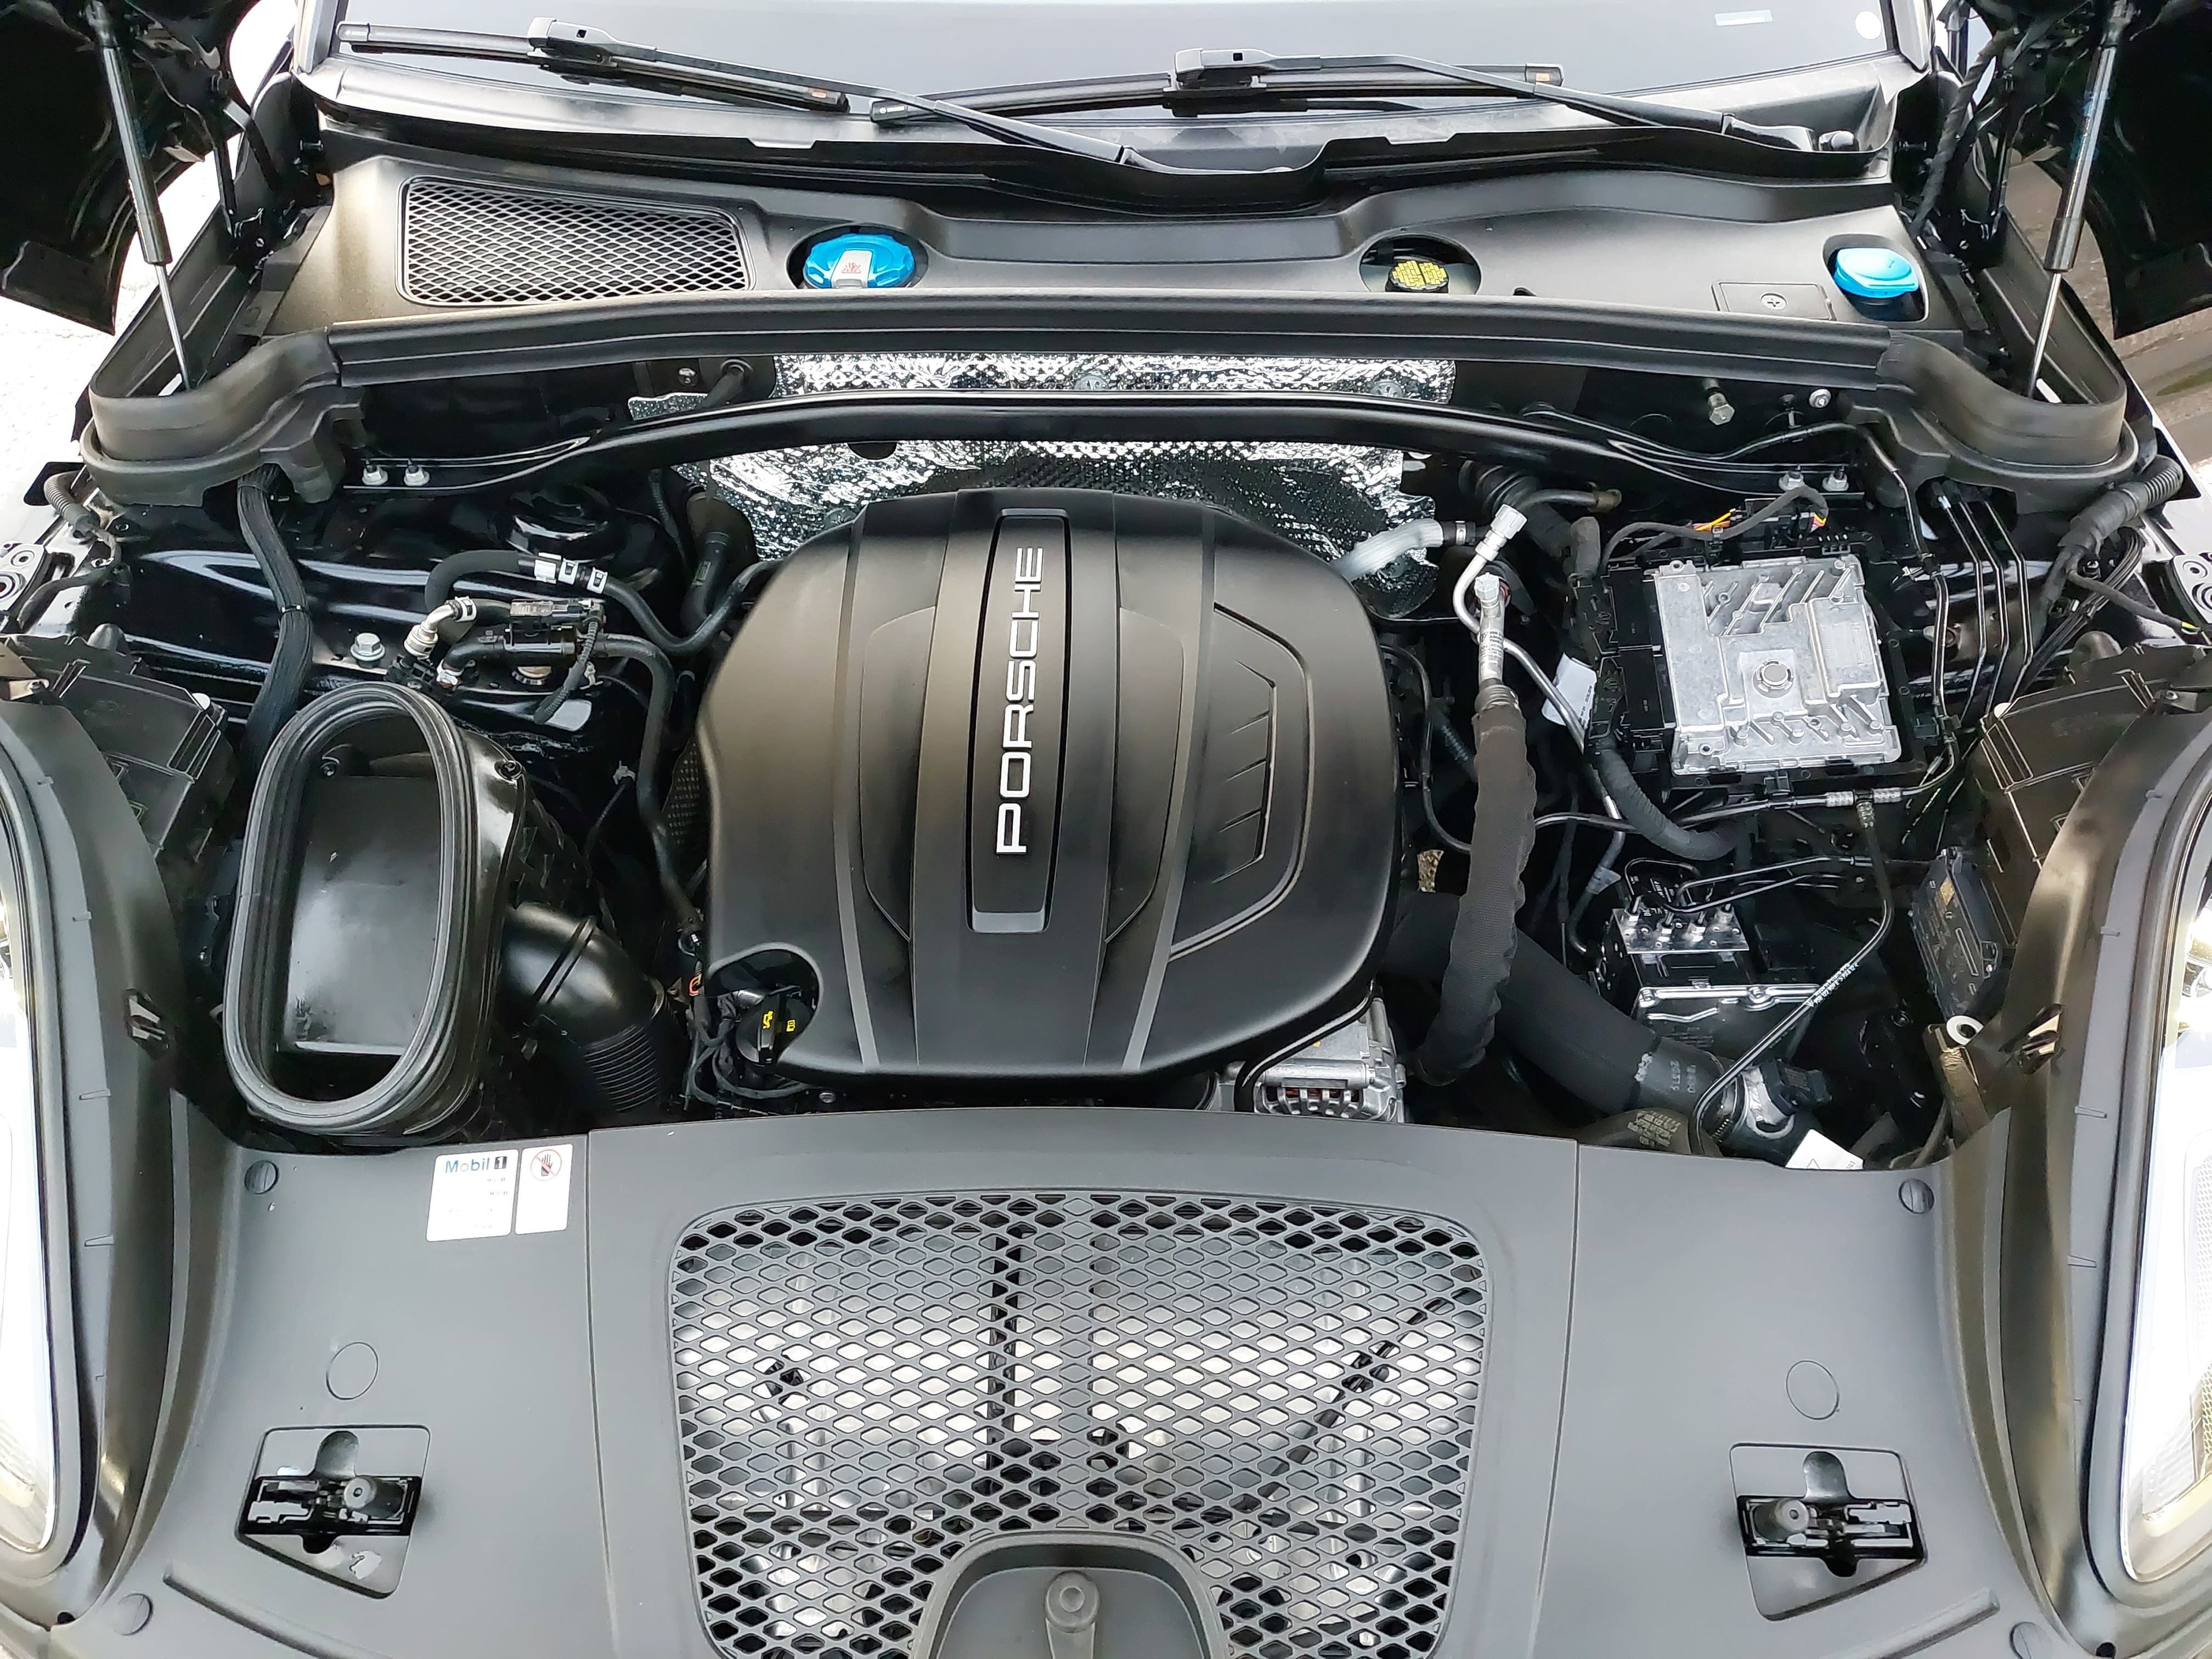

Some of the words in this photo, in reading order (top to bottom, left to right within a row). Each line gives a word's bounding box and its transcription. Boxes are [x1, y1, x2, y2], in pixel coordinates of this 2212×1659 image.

[996, 547, 1043, 855] PORSCHE
[445, 1157, 490, 1173] Mobil
[494, 1156, 507, 1170] 1
